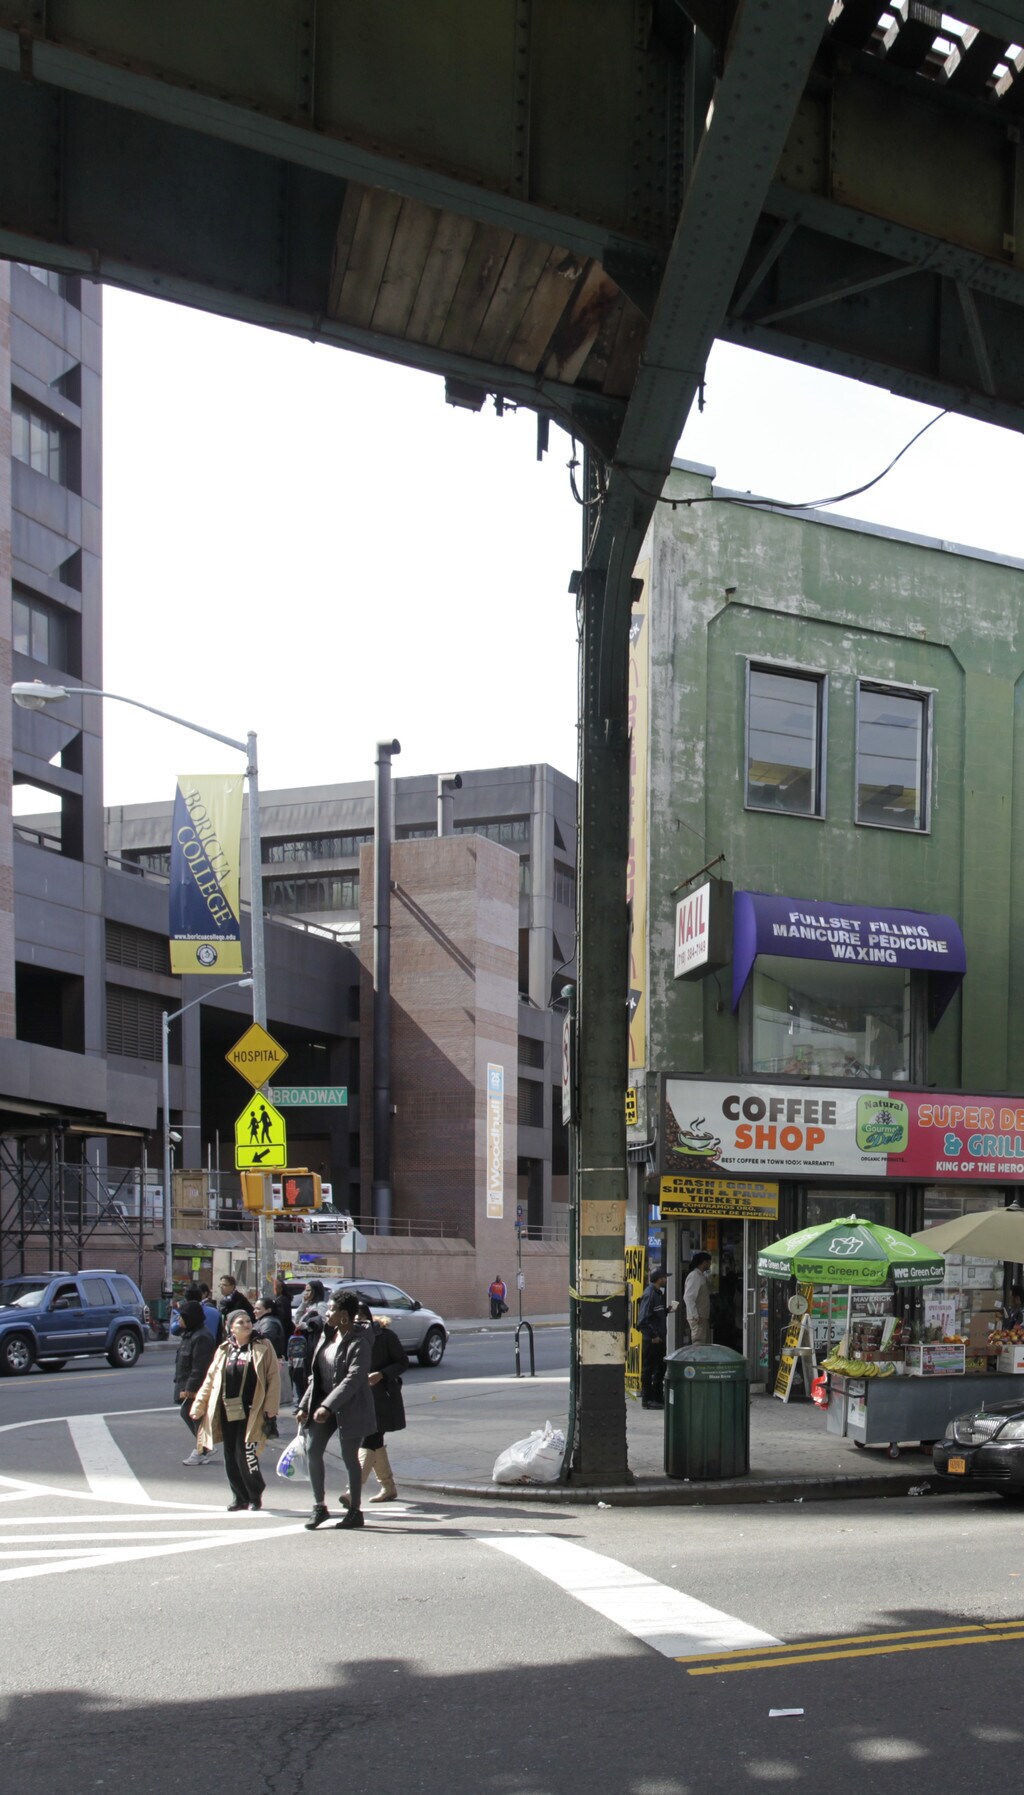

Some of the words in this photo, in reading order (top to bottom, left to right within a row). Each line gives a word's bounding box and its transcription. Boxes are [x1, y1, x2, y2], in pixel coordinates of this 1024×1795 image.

[184, 790, 232, 886] BORICUA
[177, 826, 233, 927] COLLEGE
[678, 894, 705, 948] NAIL
[789, 912, 861, 931] FULLSET
[869, 921, 930, 937] FILLING
[772, 923, 861, 945] MANICURE
[868, 934, 949, 953] PEDICURE
[830, 944, 897, 963] WAXING
[233, 1050, 280, 1063] HOSPITAL
[273, 1089, 345, 1104] BROADWAY
[864, 1099, 904, 1112] Natural
[722, 1095, 837, 1125] COFFEE
[917, 1103, 995, 1130] SUPER
[490, 1099, 502, 1189] Woodhull
[734, 1124, 826, 1152] SHOP
[943, 1132, 963, 1156] &
[936, 1161, 959, 1172] KING
[961, 1161, 975, 1172] OF
[977, 1162, 996, 1173] THE
[662, 1186, 715, 1196] SILVER
[732, 1190, 777, 1199] PAWN
[672, 1178, 715, 1188] CASH
[682, 1202, 734, 1210] COMPRAMOS
[689, 1195, 752, 1206] TICKETS
[625, 1249, 643, 1283] CASH
[796, 1264, 823, 1275] NYC
[827, 1265, 859, 1277] Green
[861, 1266, 886, 1278] Cart
[894, 1268, 909, 1278] NYC
[910, 1266, 930, 1277] Green
[930, 1265, 945, 1276] Cart
